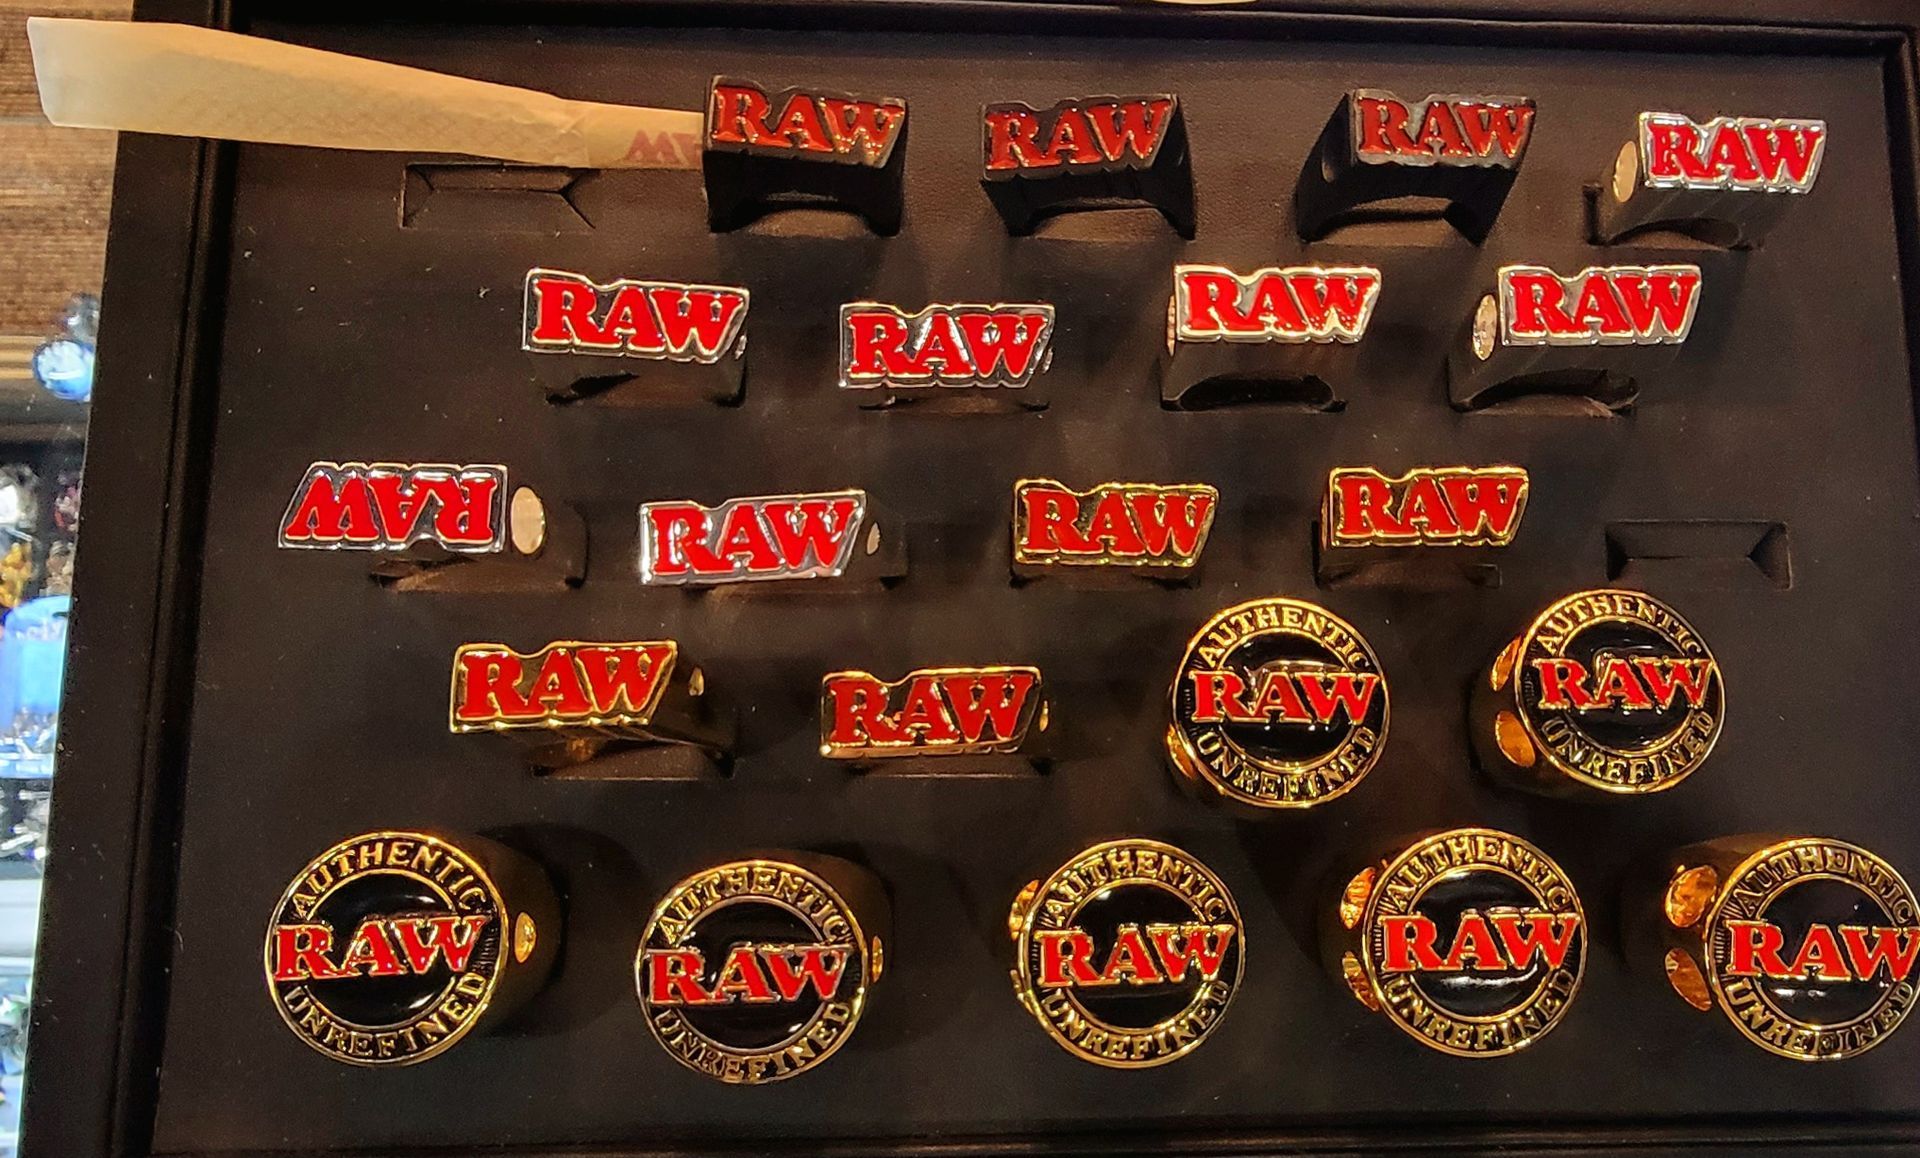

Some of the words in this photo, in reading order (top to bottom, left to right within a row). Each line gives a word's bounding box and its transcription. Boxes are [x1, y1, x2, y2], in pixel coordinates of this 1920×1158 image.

[711, 83, 904, 163] RAW
[985, 100, 1173, 171] RAW
[1357, 97, 1535, 159] RAW
[1648, 121, 1823, 184] RAW
[530, 278, 742, 352] RAW
[1182, 272, 1375, 335] RAW
[1508, 273, 1700, 336] RAW
[848, 311, 1046, 379] RAW
[284, 474, 498, 542] RAW
[649, 500, 856, 576] RAW
[1021, 488, 1215, 557] RAW
[1334, 476, 1527, 538] RAW
[1198, 606, 1370, 669] AUTHENTIC
[1536, 594, 1702, 655] AUTHENTIC
[457, 647, 674, 720] RAW
[830, 674, 1035, 746] RAW
[1189, 669, 1381, 725] RAW
[1532, 655, 1716, 710] RAW
[1197, 726, 1377, 800] UNREFINED
[1541, 710, 1715, 784] UNREFINED
[292, 841, 486, 917] AUTHENTIC
[659, 867, 850, 944] AUTHENTIC
[1045, 848, 1227, 927] AUTHENTIC
[1387, 835, 1570, 911] AUTHENTIC
[1734, 846, 1912, 925] AUTHENTIC
[274, 915, 489, 982] RAW
[646, 943, 851, 1005] RAW
[1033, 924, 1236, 987] RAW
[1378, 913, 1580, 971] RAW
[1725, 919, 1920, 982] RAW
[284, 972, 487, 1057] UNREFINED
[654, 1002, 850, 1083] UNREFINED
[1042, 981, 1230, 1060] UNREFINED
[1385, 969, 1575, 1050] UNREFINED
[1725, 977, 1913, 1055] UNREFINED
